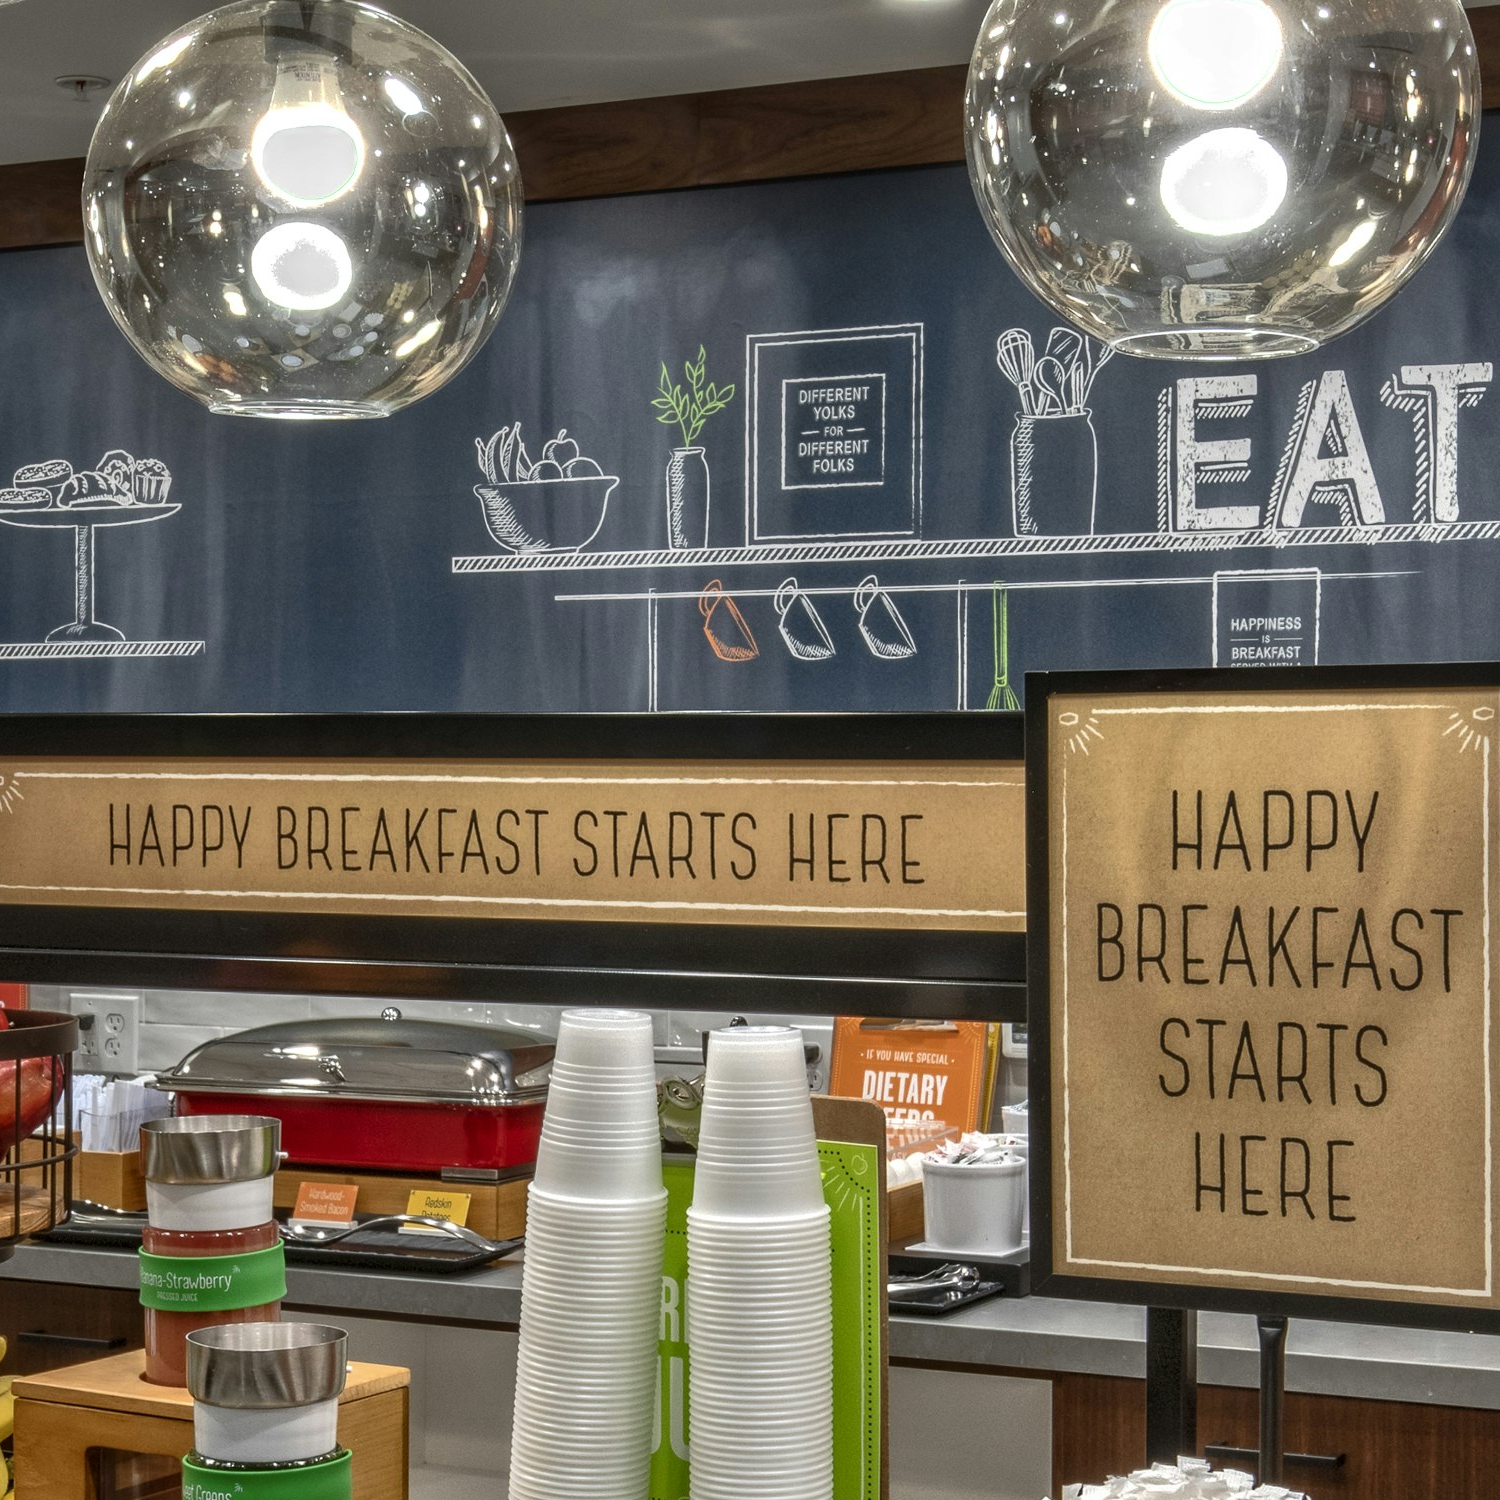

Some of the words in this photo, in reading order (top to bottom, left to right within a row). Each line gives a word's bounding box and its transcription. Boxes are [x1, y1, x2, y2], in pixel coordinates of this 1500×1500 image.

[799, 386, 870, 404] DIFFERENT
[813, 404, 856, 421] YOLKS
[824, 426, 844, 437] FOR
[798, 439, 870, 457] DIFFERENT
[1160, 362, 1493, 533] EAT
[813, 458, 855, 474] FOLKS
[1231, 617, 1302, 631] HAPPINESS
[1261, 634, 1271, 643] IS
[1231, 646, 1301, 659] BREAKFAST
[1171, 788, 1379, 873] HAPPY
[108, 803, 252, 870] HAPPY
[276, 805, 549, 876] BREAKFAST
[572, 809, 758, 881] STARTS
[788, 812, 926, 885] HERE
[1096, 902, 1464, 994] BREAKFAST
[866, 1049, 875, 1060] IF
[876, 1050, 891, 1061] YOU
[894, 1050, 914, 1063] HAVE
[916, 1052, 949, 1066] SPECIAL
[1158, 1017, 1389, 1108] STARTS
[862, 1069, 948, 1106] DIETARY
[1194, 1131, 1357, 1223] HERE
[309, 1189, 345, 1201] Hardwood-
[425, 1196, 453, 1209] Redskin
[300, 1202, 327, 1214] Smoked
[327, 1203, 349, 1215] Bacon
